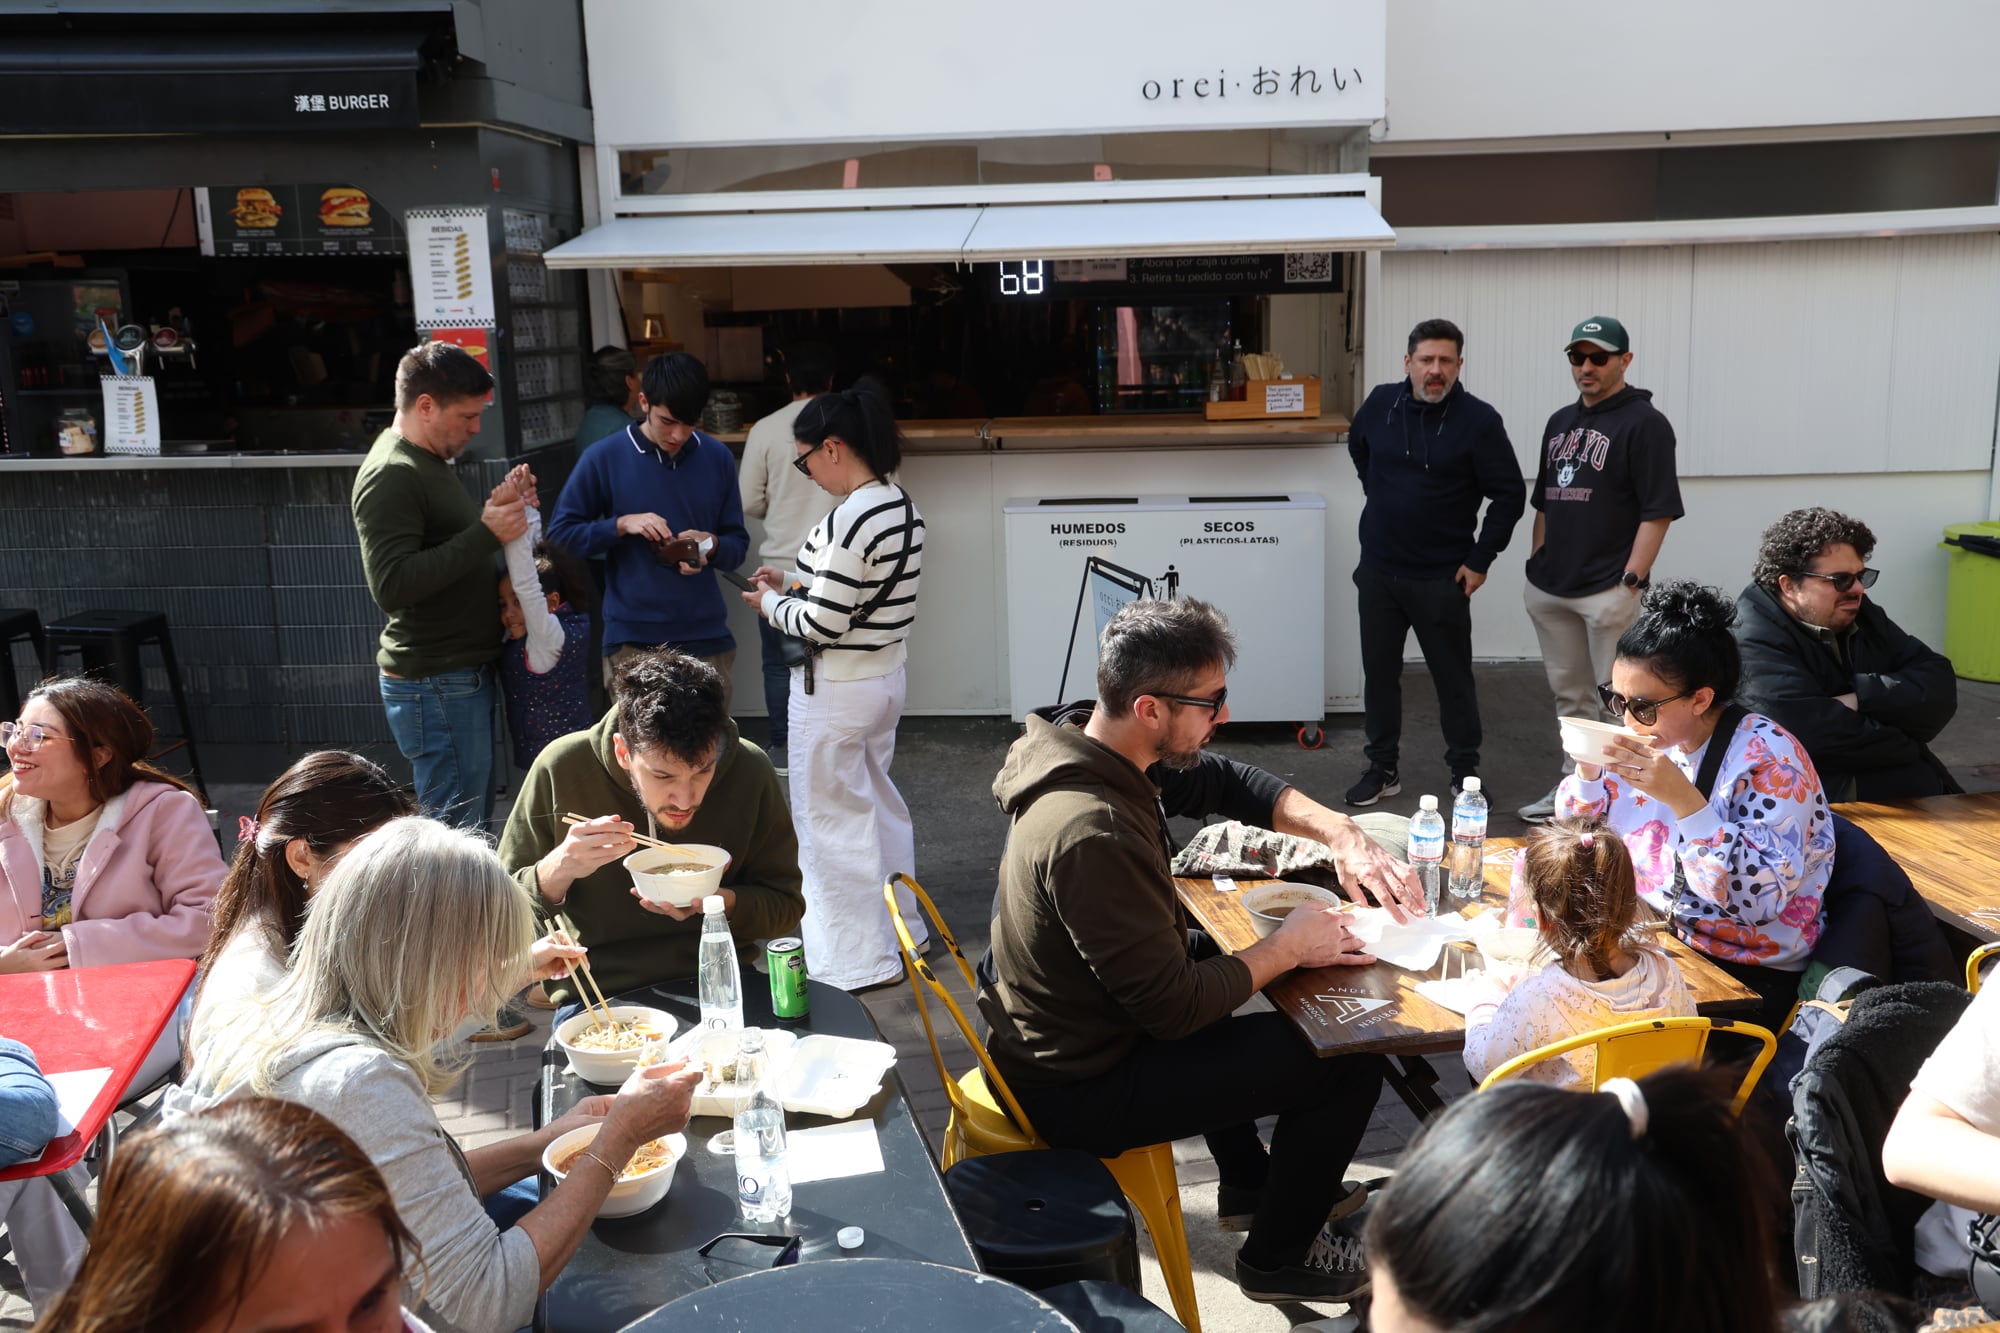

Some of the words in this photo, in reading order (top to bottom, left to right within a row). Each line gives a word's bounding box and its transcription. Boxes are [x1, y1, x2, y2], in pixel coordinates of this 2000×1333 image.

[328, 94, 390, 110] BURGER
[1176, 258, 1194, 269] por
[1230, 256, 1260, 265] online
[1142, 272, 1172, 283] Retira
[1175, 272, 1186, 282] tu
[1188, 271, 1223, 283] pedido
[1225, 272, 1244, 281] con
[1247, 270, 1257, 280] tu
[1050, 523, 1126, 535] HUMEDOS
[1203, 521, 1255, 532] SECOS
[1059, 538, 1118, 548] (RESIDUOS)
[1327, 986, 1376, 995] ANDES
[1357, 1008, 1399, 1029] ORIGEN
